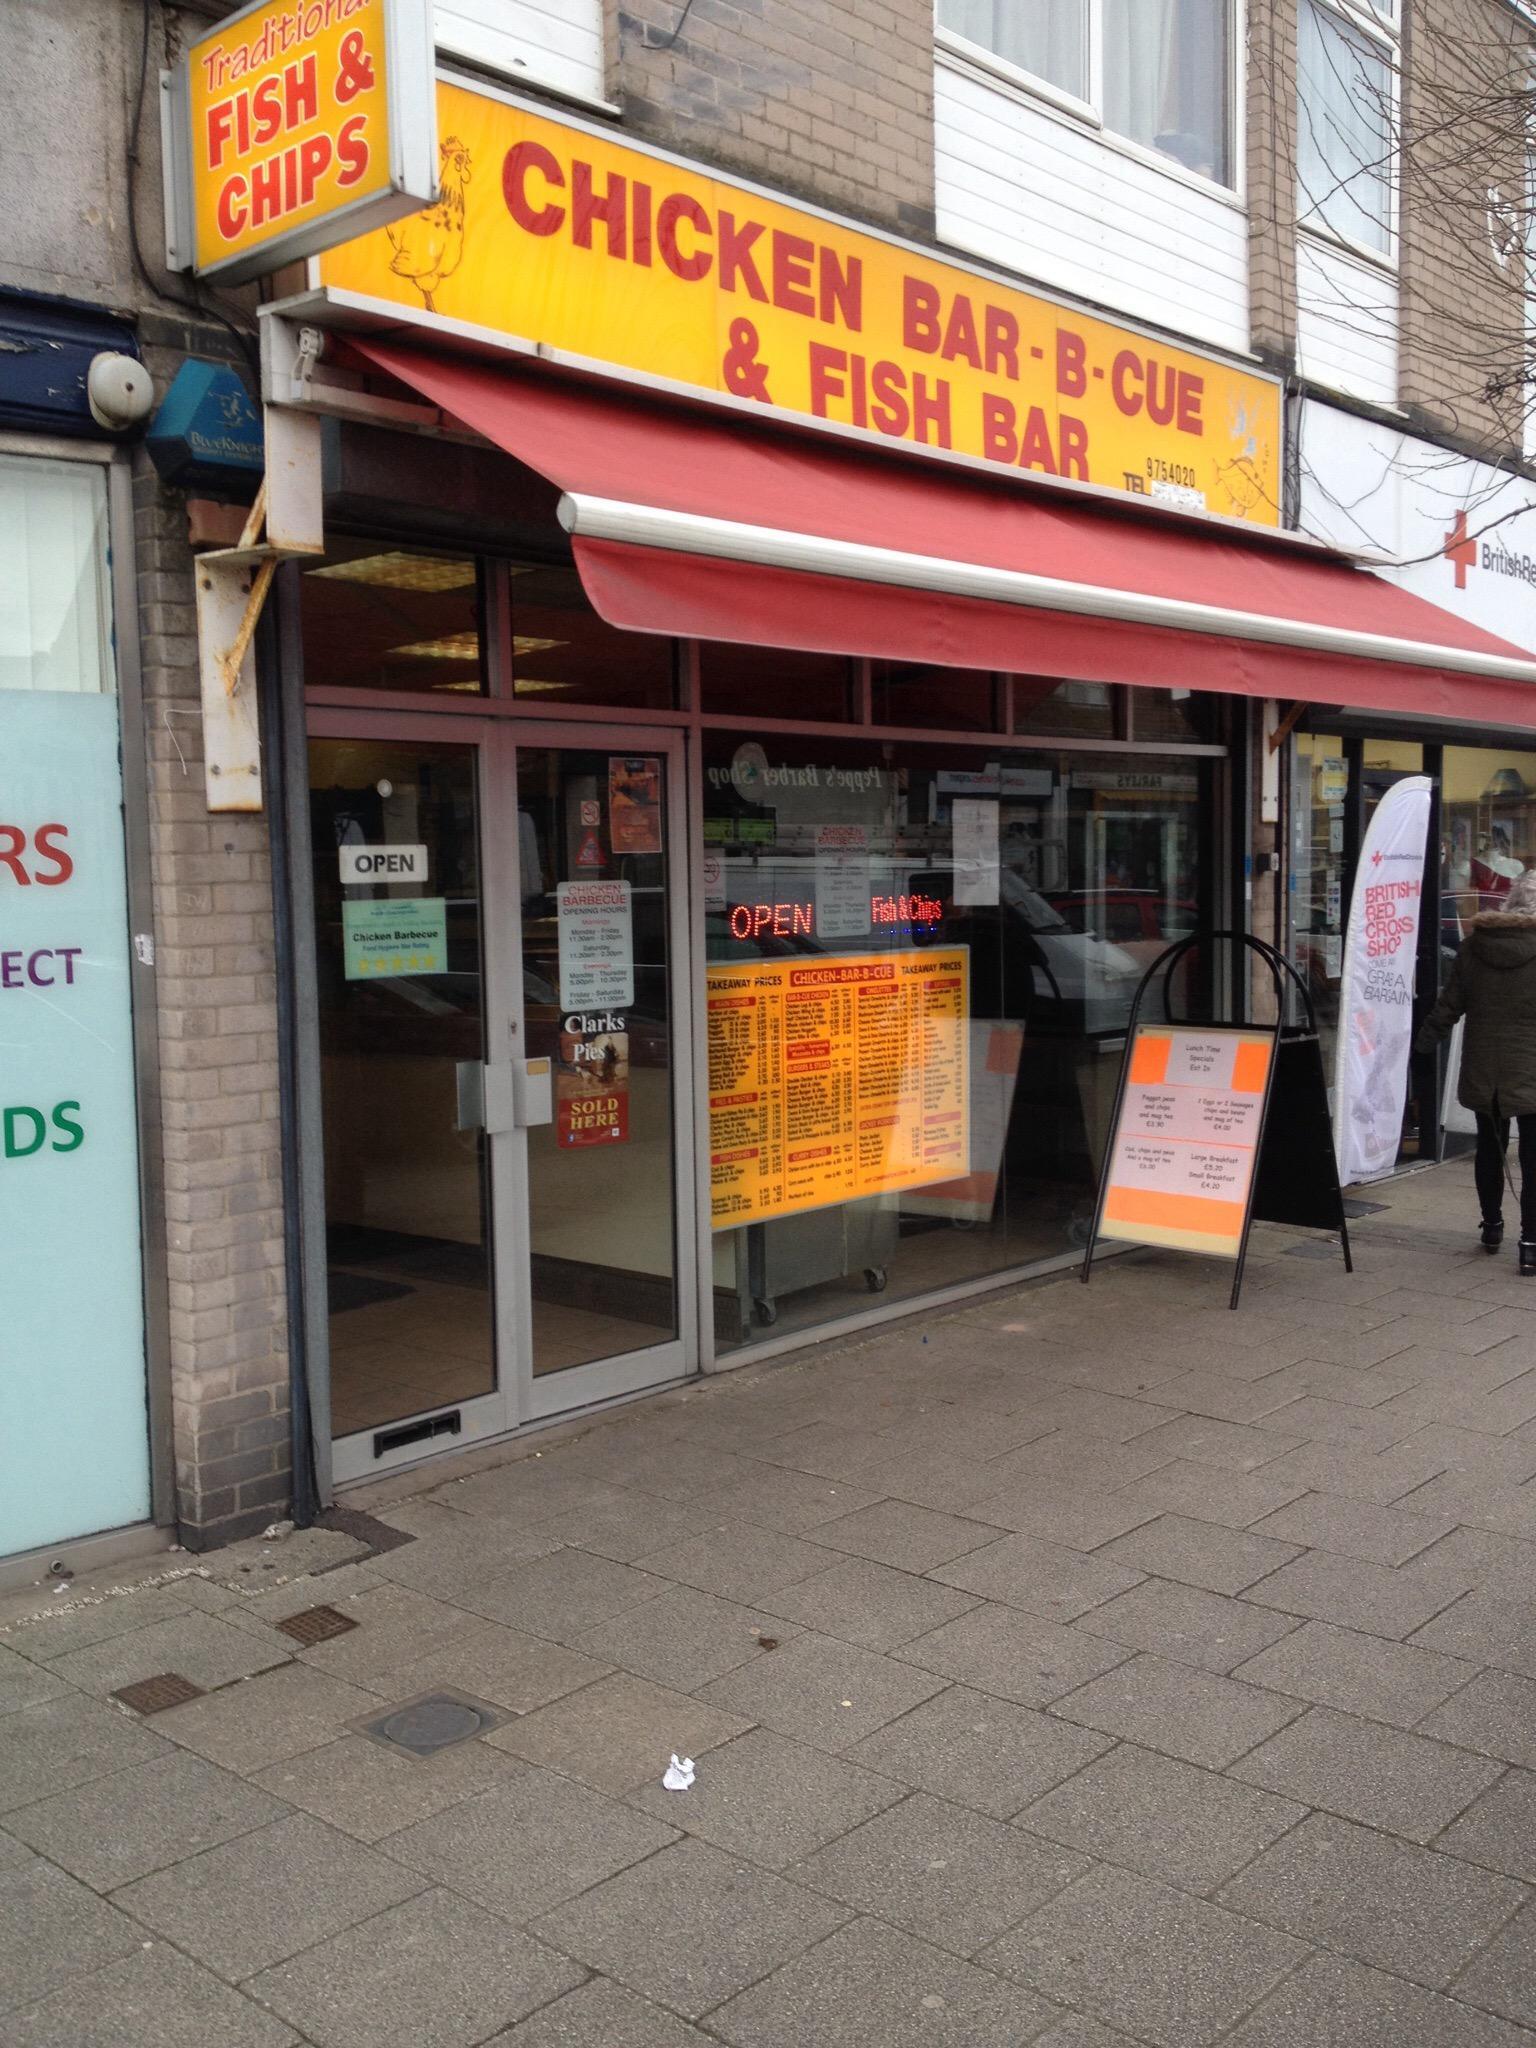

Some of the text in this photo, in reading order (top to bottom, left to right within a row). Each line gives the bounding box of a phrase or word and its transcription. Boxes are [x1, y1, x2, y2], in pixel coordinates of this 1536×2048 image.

[203, 0, 370, 91] Traditiona
[206, 30, 375, 170] FISH &
[217, 115, 369, 241] CHIPS
[502, 140, 862, 333] CHICKEN
[723, 318, 1089, 484] & FISH BAR
[1146, 457, 1195, 488] 9754020
[355, 854, 414, 873] OPEN
[568, 885, 622, 896] CHICKEN
[1365, 880, 1421, 904] BRITISH
[563, 895, 627, 906] BARBECUE
[563, 907, 599, 915] OPENING
[871, 896, 898, 922] Fish
[909, 895, 942, 926] Chips
[1366, 902, 1396, 922] RED
[731, 903, 812, 938] OPEN
[1365, 916, 1414, 939] CROSS
[353, 930, 439, 942] Chicken Barbecue
[571, 928, 620, 937] Monday Friday
[1, 948, 82, 988] ECT
[569, 972, 594, 980] Monday
[793, 965, 893, 984] CHICKEN-BAR-B-CUE
[902, 961, 962, 975] TAKEAWAY PRICES
[707, 975, 783, 991] TAKEAWAY PRICES
[1395, 973, 1406, 989] A
[569, 989, 624, 999] Friday Saturday
[564, 1013, 625, 1034] Clarks
[573, 1043, 606, 1062] Pies
[1186, 1044, 1221, 1053] Lunch Time
[1189, 1054, 1214, 1063] Specials
[1190, 1064, 1201, 1072] Eat
[571, 1098, 619, 1115] SOLD
[3, 1100, 84, 1158] DS
[570, 1112, 619, 1130] HERE
[1191, 1153, 1239, 1164] Large Breakfast
[1188, 1171, 1235, 1182] Small Breakfast
